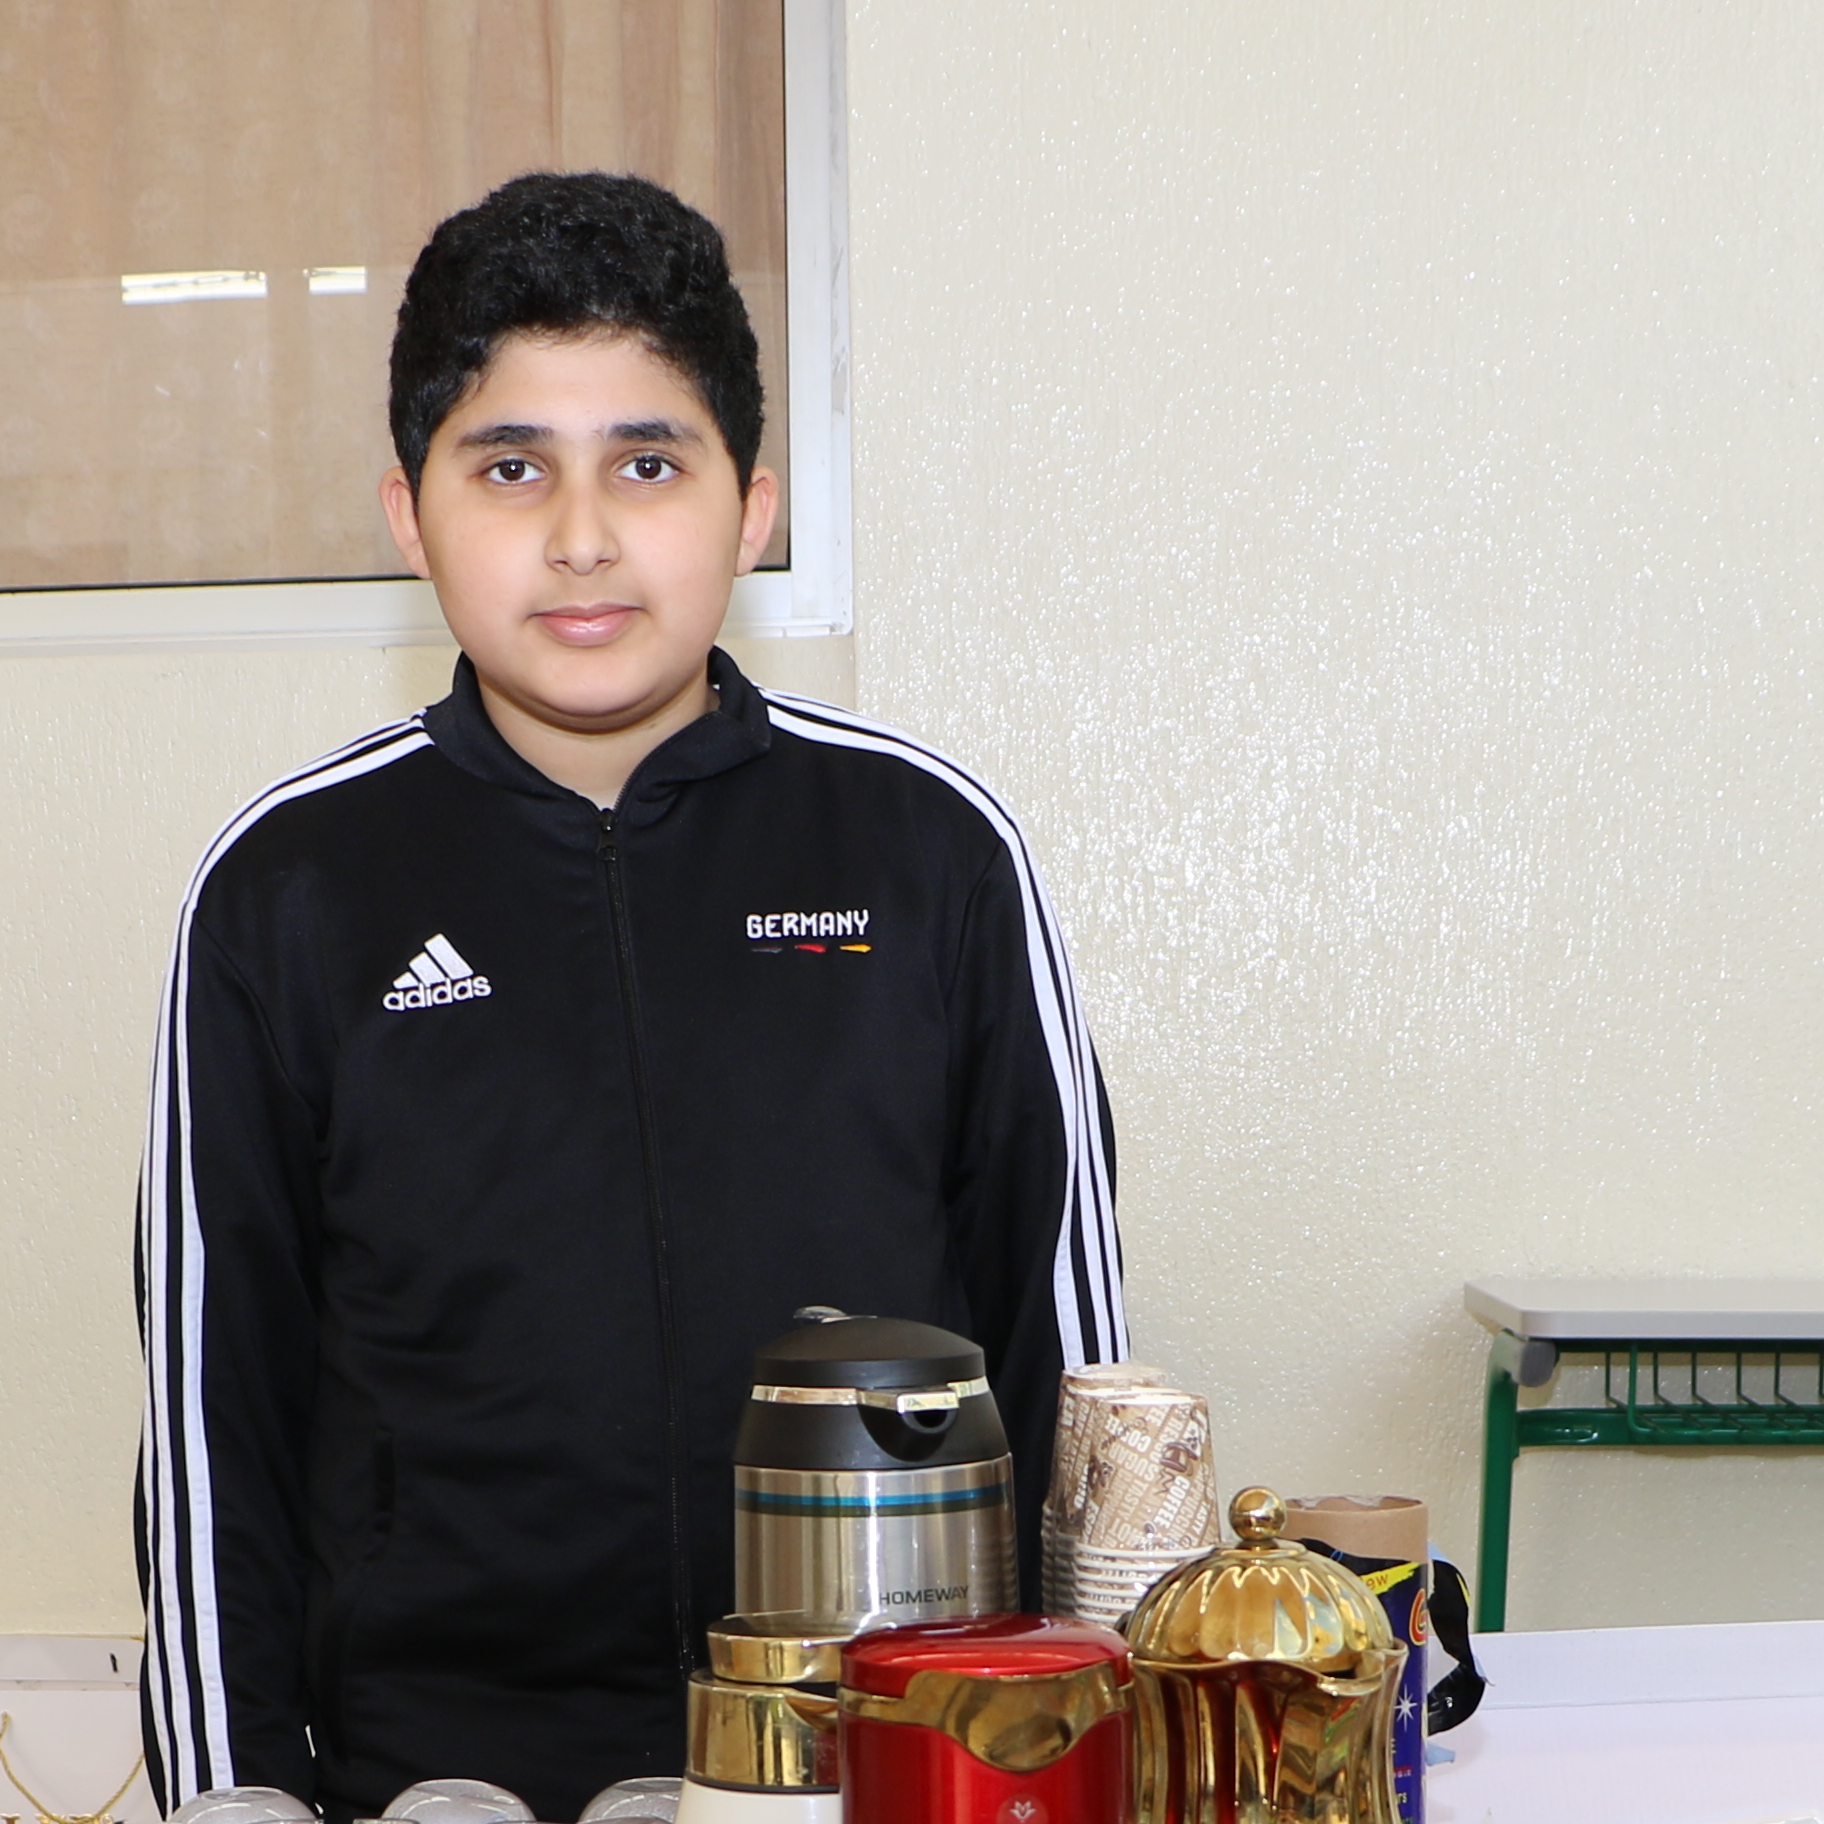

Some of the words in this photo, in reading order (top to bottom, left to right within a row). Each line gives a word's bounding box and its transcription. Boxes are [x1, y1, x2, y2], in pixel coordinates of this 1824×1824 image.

[746, 909, 869, 939] GERMANY
[382, 975, 492, 1011] adidas
[1107, 1441, 1159, 1483] SUGAR
[1116, 1478, 1150, 1521] TASTY
[1153, 1475, 1191, 1530] COFFEE
[879, 1585, 969, 1606] HOMEWAY
